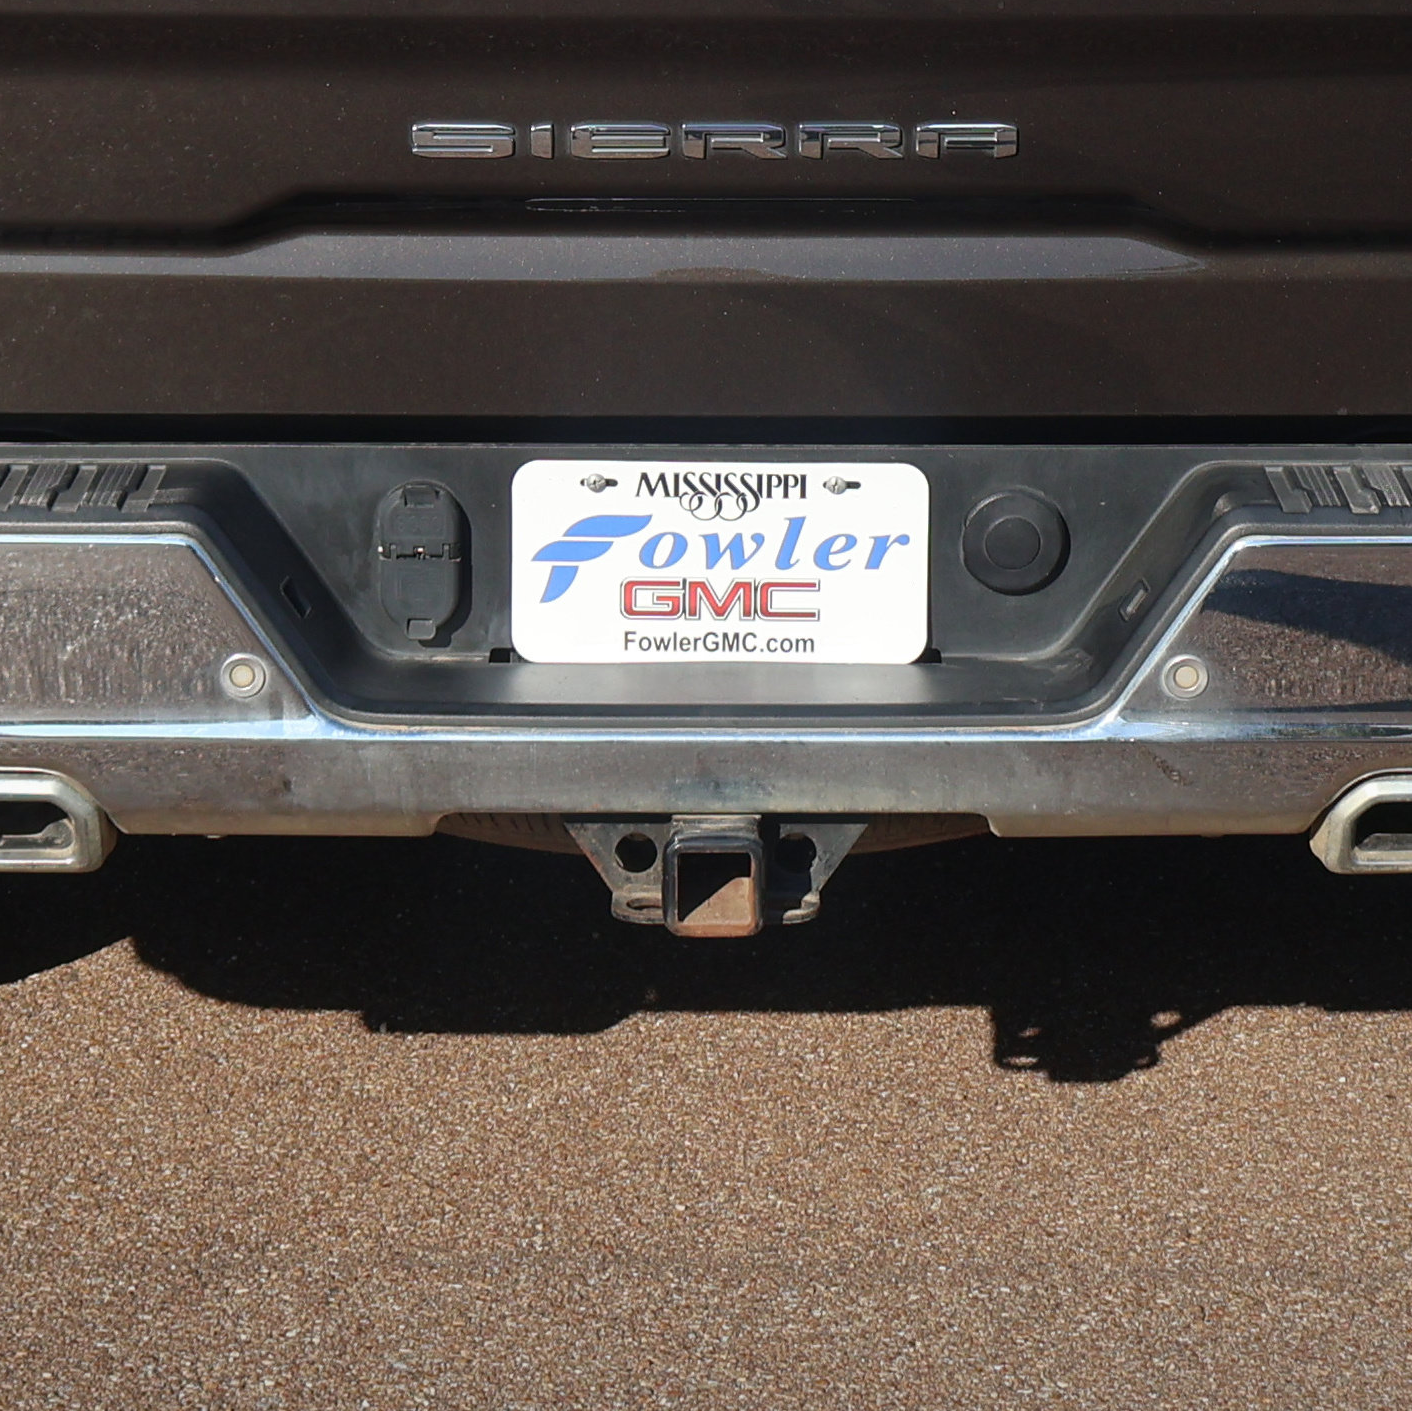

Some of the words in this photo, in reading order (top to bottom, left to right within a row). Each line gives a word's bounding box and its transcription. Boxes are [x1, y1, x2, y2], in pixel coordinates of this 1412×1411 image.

[411, 123, 1019, 160] SIERRA
[635, 471, 808, 521] MISSISSIPPI
[531, 514, 910, 604] Fowler
[620, 576, 821, 622] GMC
[624, 631, 815, 654] FowlerGMC.com
